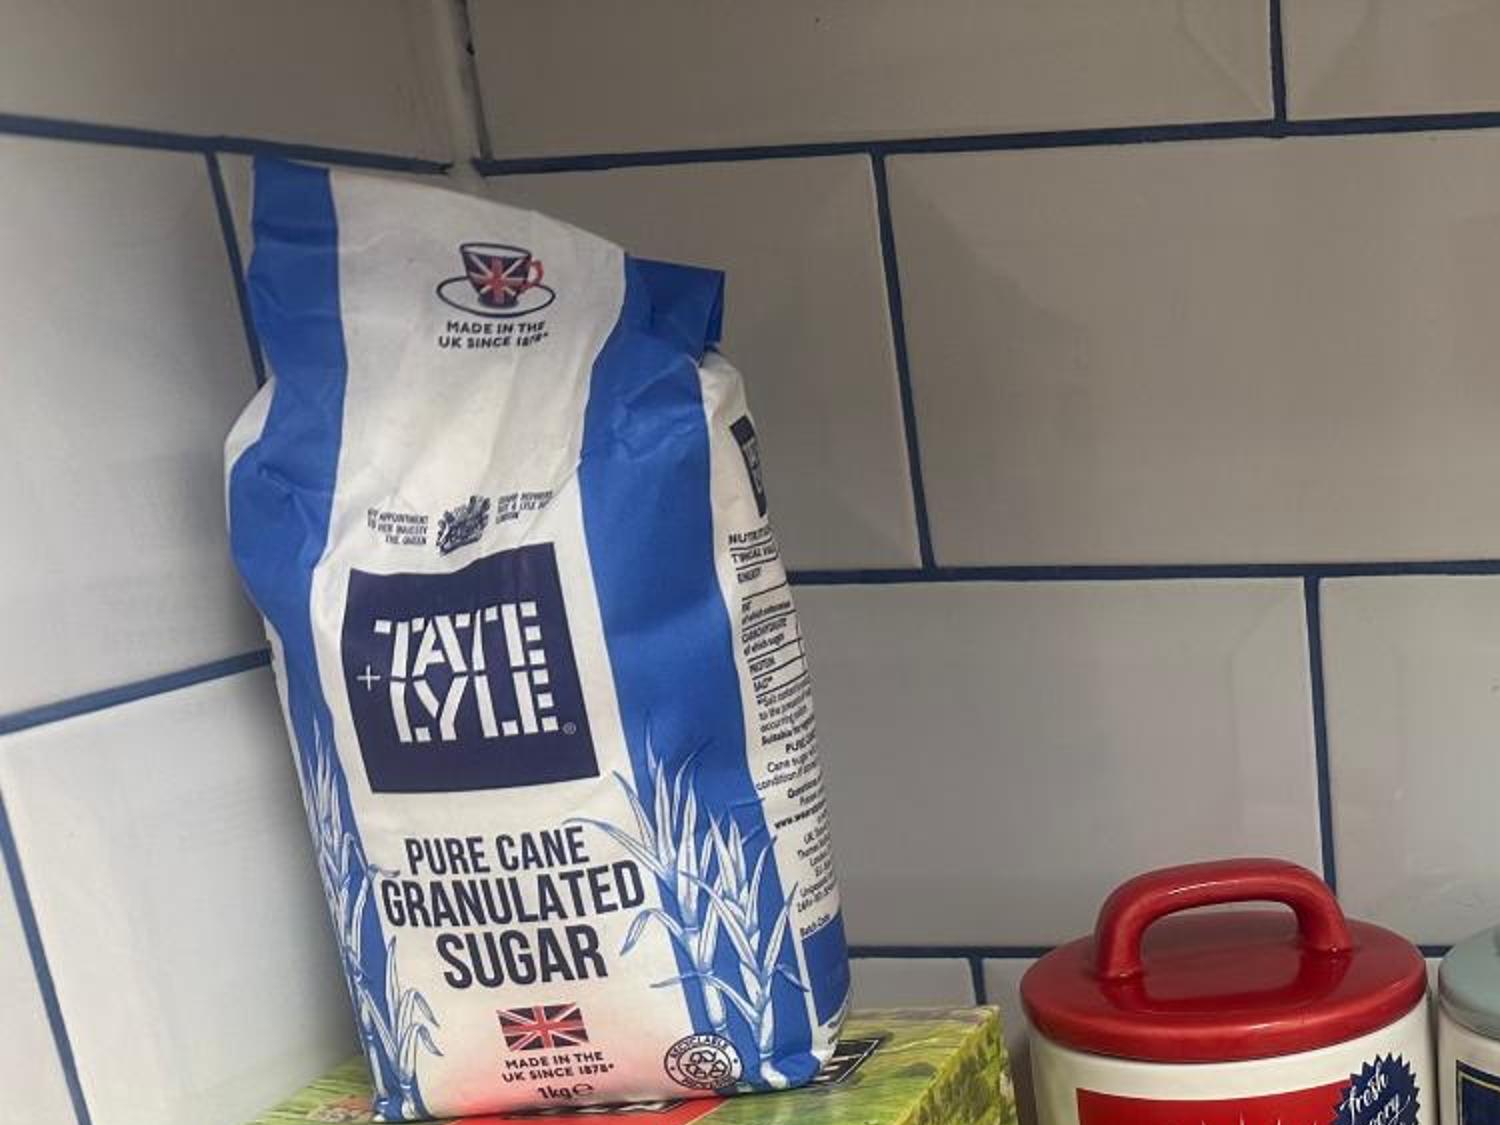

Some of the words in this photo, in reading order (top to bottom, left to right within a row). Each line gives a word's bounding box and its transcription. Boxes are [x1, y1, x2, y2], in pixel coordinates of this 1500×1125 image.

[438, 336, 462, 348] UK
[467, 336, 511, 348] SINCE
[447, 321, 492, 333] MADE
[497, 323, 514, 334] IN
[374, 602, 547, 677] TATE
[389, 668, 560, 743] LYLE
[405, 836, 490, 876] PURE
[496, 826, 590, 871] CANE
[381, 859, 645, 928] GRANULATED
[436, 924, 608, 988] SUGAR
[503, 1070, 526, 1083] UK
[530, 1067, 575, 1080] SINCE
[505, 1058, 549, 1070] MADE
[553, 1055, 571, 1065] IN
[577, 1052, 604, 1062] THE
[538, 1086, 571, 1100] 1kg
